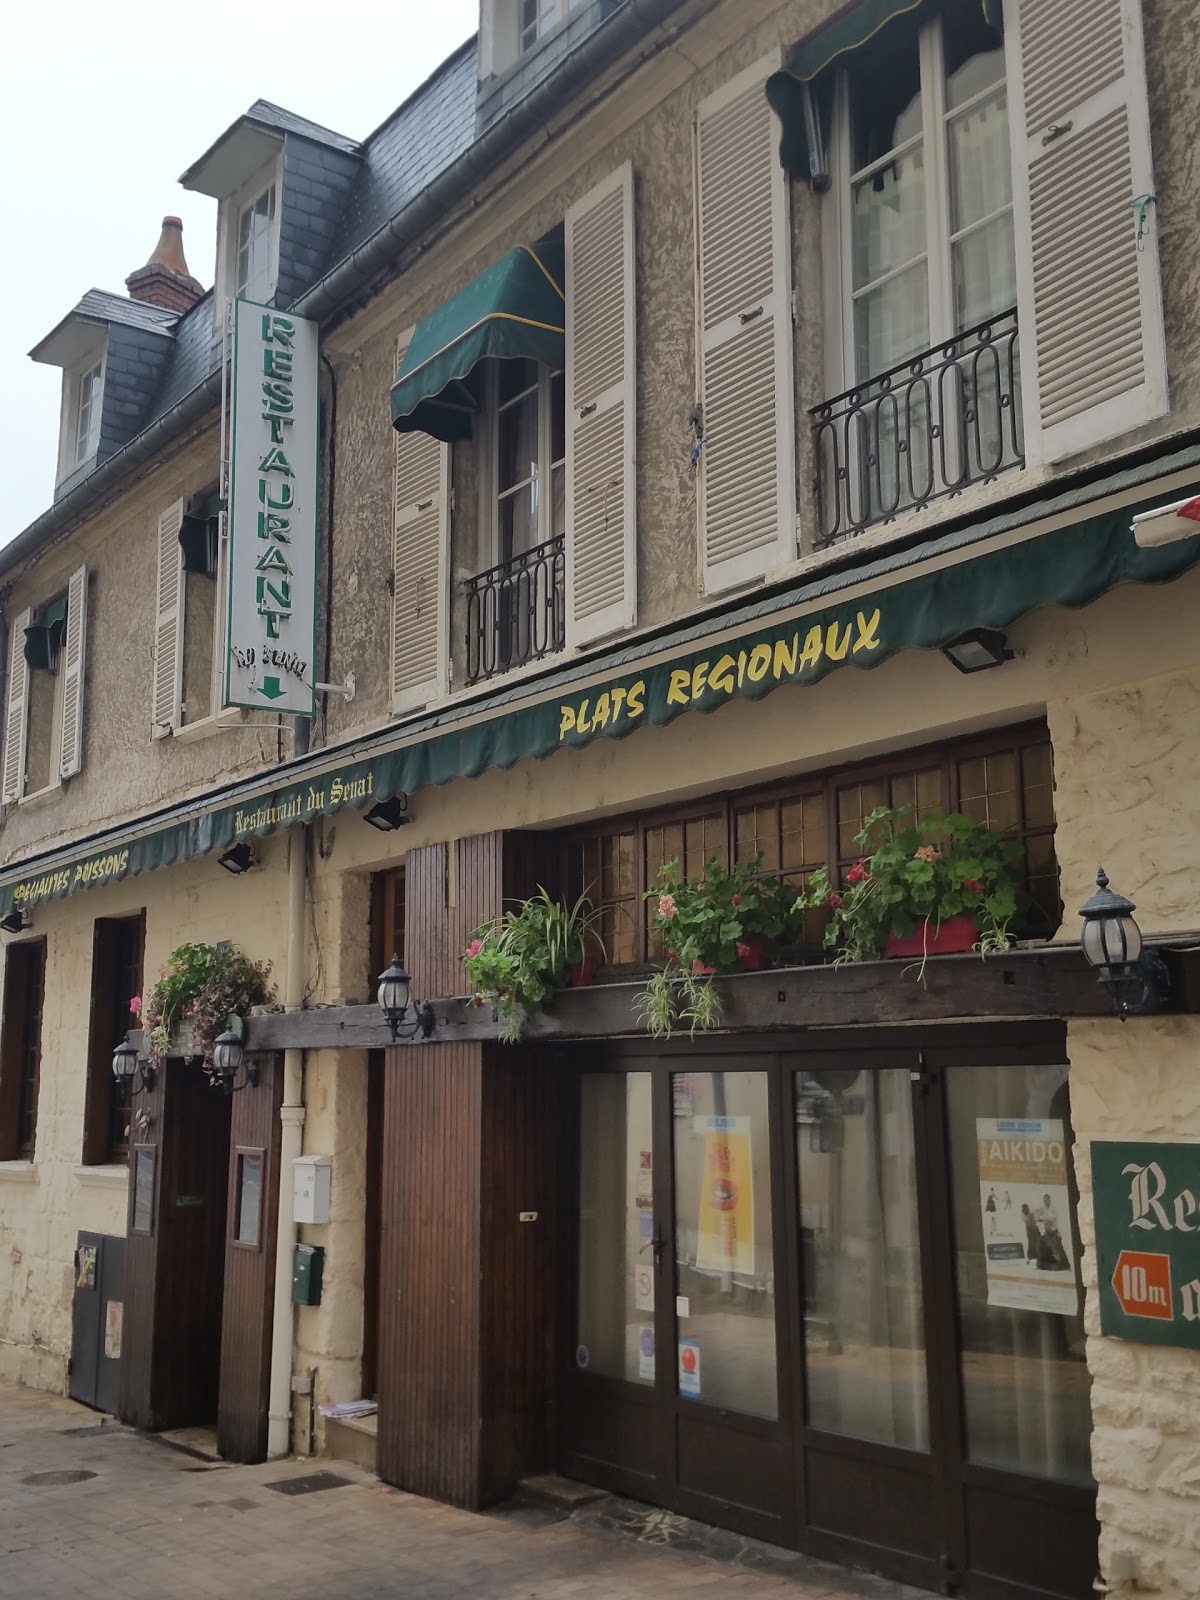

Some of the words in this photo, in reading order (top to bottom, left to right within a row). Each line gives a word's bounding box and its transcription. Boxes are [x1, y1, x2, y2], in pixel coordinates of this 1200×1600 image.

[254, 312, 296, 640] RESTAURANT
[559, 680, 646, 741] PLATS
[666, 608, 881, 705] REGIONAUX
[234, 794, 302, 835] Restaurant
[306, 786, 325, 812] du
[329, 771, 374, 805] Senat
[74, 849, 129, 885] POISSONS
[989, 1140, 1064, 1164] AIKIDO
[1121, 1161, 1200, 1232] Re
